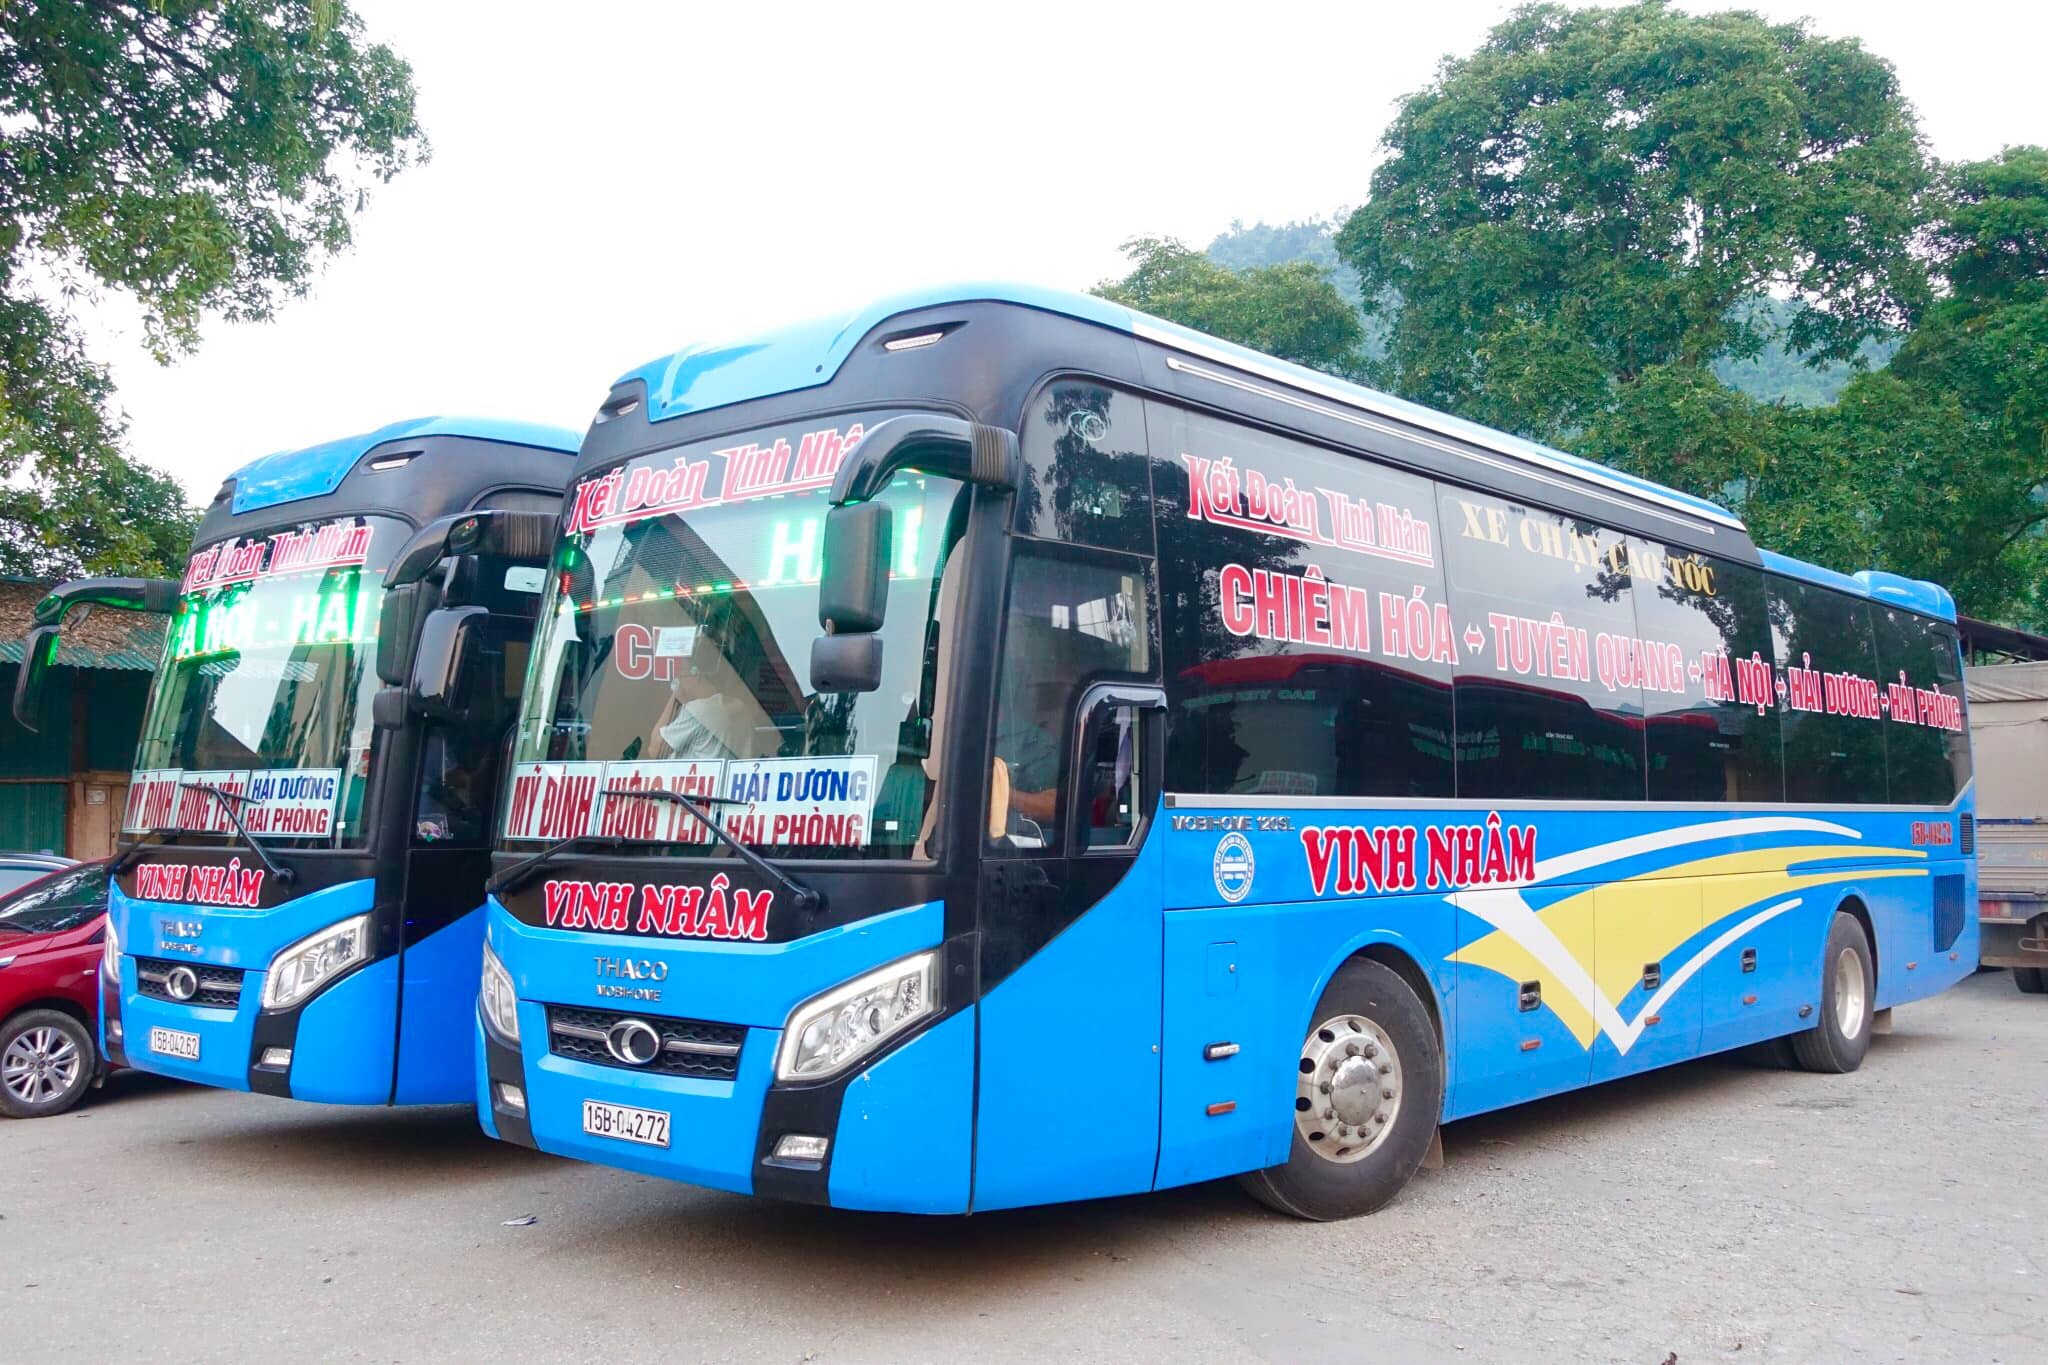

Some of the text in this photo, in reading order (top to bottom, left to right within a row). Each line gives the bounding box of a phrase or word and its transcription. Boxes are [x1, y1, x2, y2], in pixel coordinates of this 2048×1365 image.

[711, 438, 793, 500] Vinh
[1458, 500, 1511, 547] XE
[1518, 517, 1602, 574] CHẠY
[1607, 539, 1665, 583] CAO
[1219, 564, 1963, 732] CHIÊM HÓA TUYÊN QUANG HÀ NỘI HẢI DƯƠNG HẢI PHÒNG
[279, 776, 334, 800] DƯƠNG
[508, 764, 543, 836] MỸ
[730, 762, 868, 803] HẢI DƯƠNG
[271, 804, 329, 833] PHÒNG
[725, 803, 864, 848] HẢI PHÒNG
[1300, 825, 1417, 896] VINH
[1425, 810, 1537, 889] NHÂM
[136, 857, 264, 906] VINH NHÂM
[544, 872, 773, 941] VINH NHÂM
[593, 956, 669, 982] THACO
